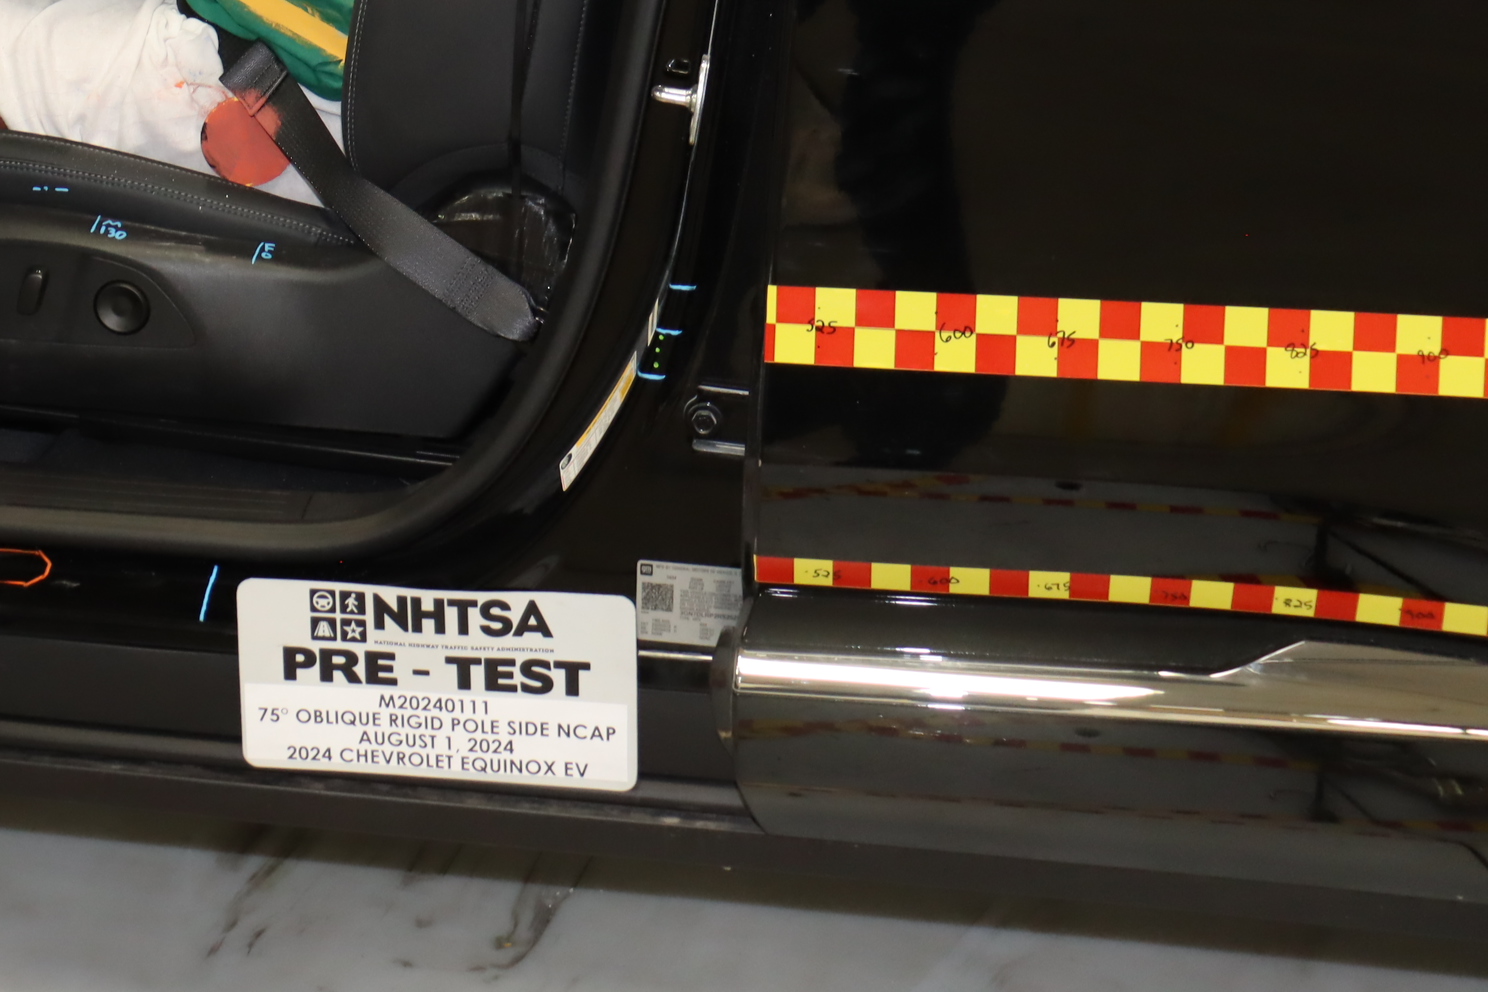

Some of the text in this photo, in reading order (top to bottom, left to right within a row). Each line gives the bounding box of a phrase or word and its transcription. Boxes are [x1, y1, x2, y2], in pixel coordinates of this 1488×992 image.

[806, 317, 838, 335] 525
[938, 322, 977, 343] 600
[1047, 330, 1077, 349] 675
[1164, 336, 1195, 353] 750
[1284, 342, 1320, 360] 825
[1417, 347, 1450, 365] 900
[812, 568, 843, 580] 525
[928, 576, 961, 586] 600
[1044, 581, 1071, 592] 675
[372, 591, 554, 639] NHTSA
[373, 639, 407, 648] NATIONAL
[283, 645, 398, 687] PRE
[445, 655, 591, 697] TEST
[378, 693, 489, 715] M20240111
[258, 706, 617, 742] 75° OBLIQUE RIGID POLE SIDE NCAP
[358, 730, 515, 754] AUGUST 1, 2024
[286, 745, 589, 778] 2024 CHEVROLET EQUINOX EV
